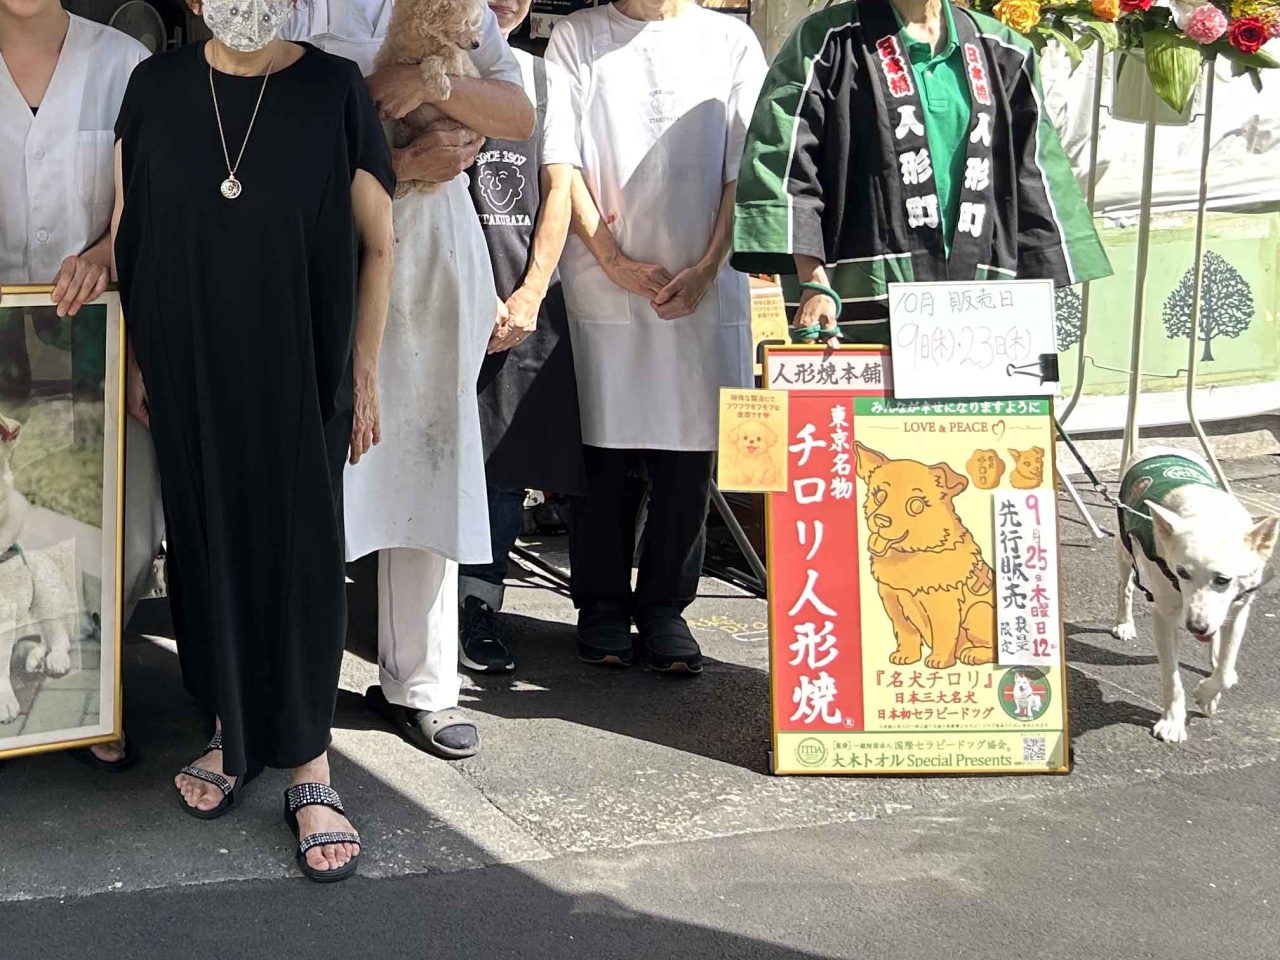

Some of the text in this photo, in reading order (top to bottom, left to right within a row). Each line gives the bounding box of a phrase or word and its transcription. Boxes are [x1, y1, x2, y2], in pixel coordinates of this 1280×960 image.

[877, 35, 939, 230] 日本橋 人形町
[958, 42, 991, 238] 日本橋 人形町
[502, 151, 527, 166] 1907
[894, 288, 1014, 316] 10月 販売日
[772, 362, 882, 385] 人形焼本舗
[904, 422, 988, 432] LOVE & PEACE
[829, 404, 853, 500] 東京名物
[999, 499, 1029, 610] 先行販売
[788, 423, 842, 725] チロリ人形焼
[876, 670, 993, 689] 『名犬チロリ』
[895, 691, 978, 704] 日本三大名犬
[878, 707, 994, 720] 日本初セラピードッグ
[832, 753, 1012, 768] 大木トオル Special Presents
